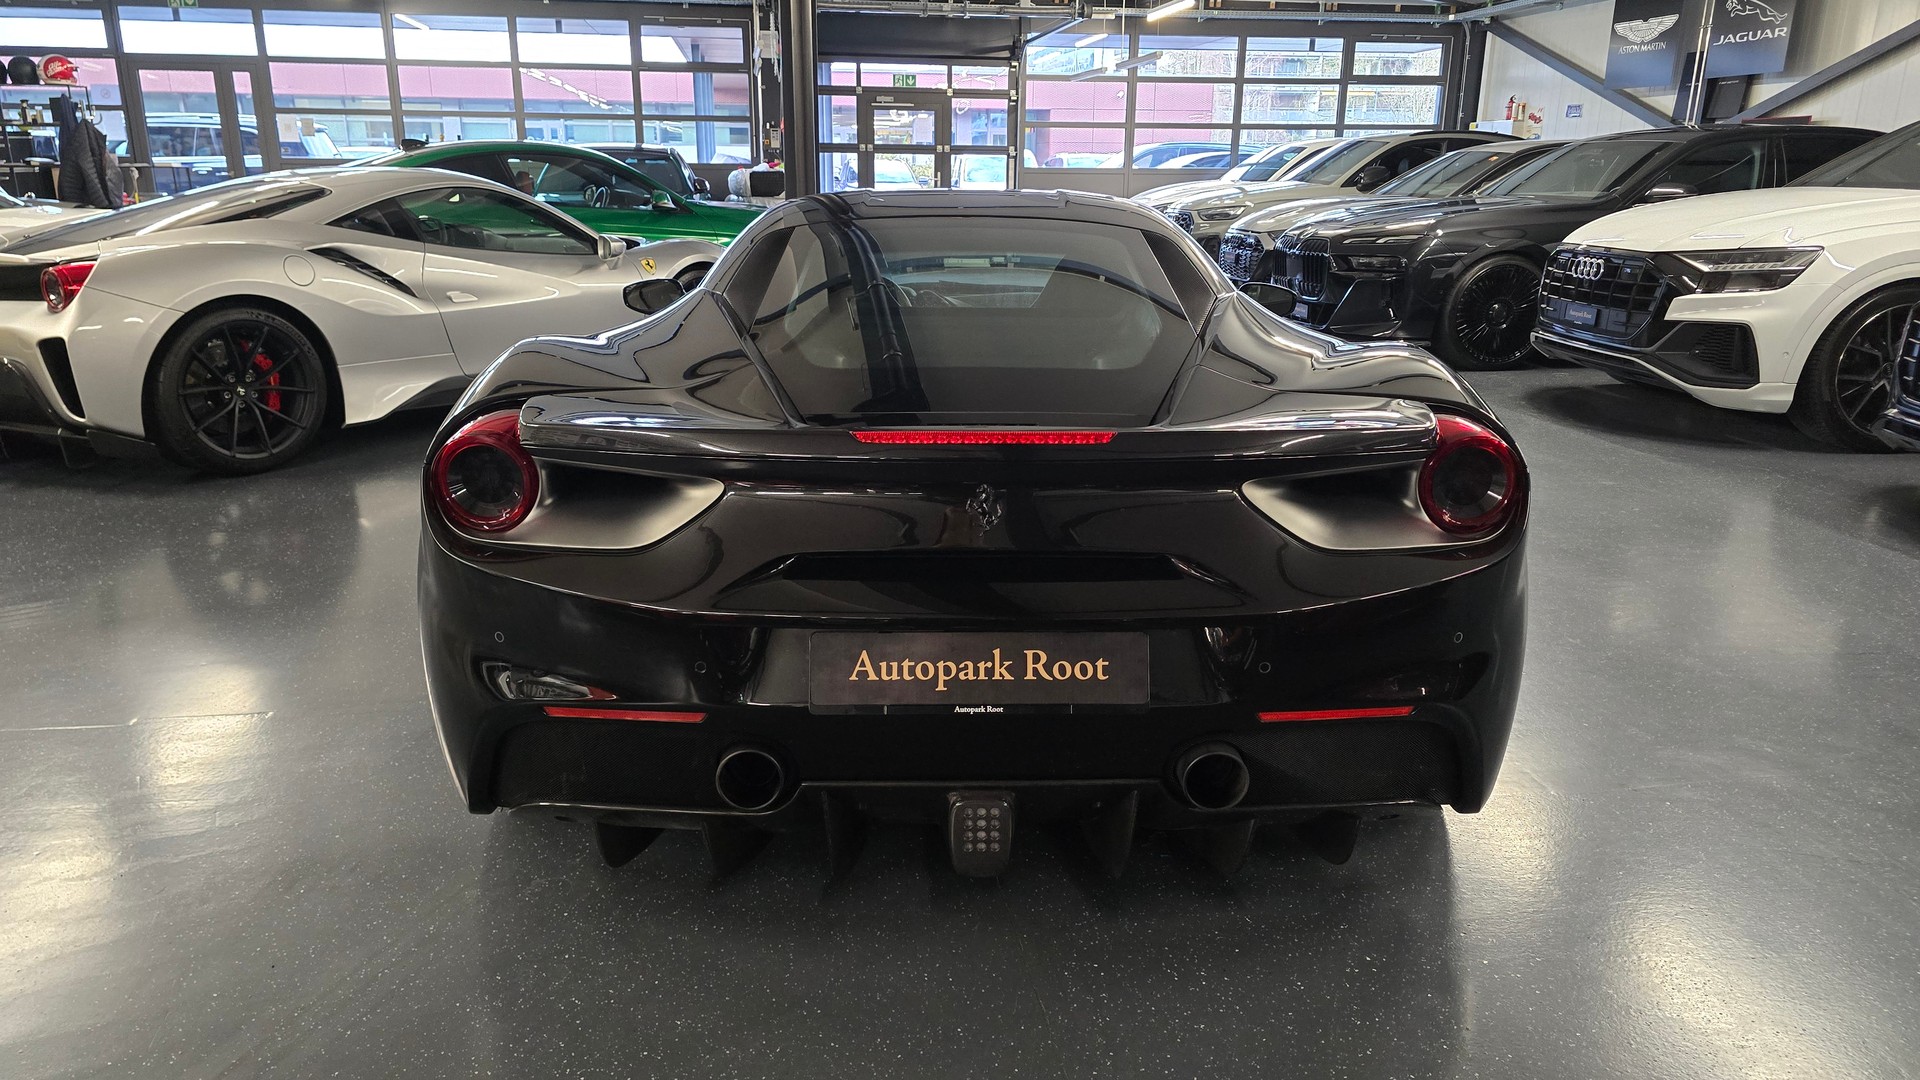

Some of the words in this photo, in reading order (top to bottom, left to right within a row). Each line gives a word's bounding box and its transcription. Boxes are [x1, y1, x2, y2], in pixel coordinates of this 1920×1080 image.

[1713, 27, 1787, 46] JAGUAR
[1618, 44, 1640, 55] ASTON
[1640, 41, 1667, 52] MARTIN
[849, 648, 1014, 691] Autopark
[1024, 649, 1109, 681] Root
[954, 705, 986, 714] Autopark
[986, 705, 1004, 713] Root
